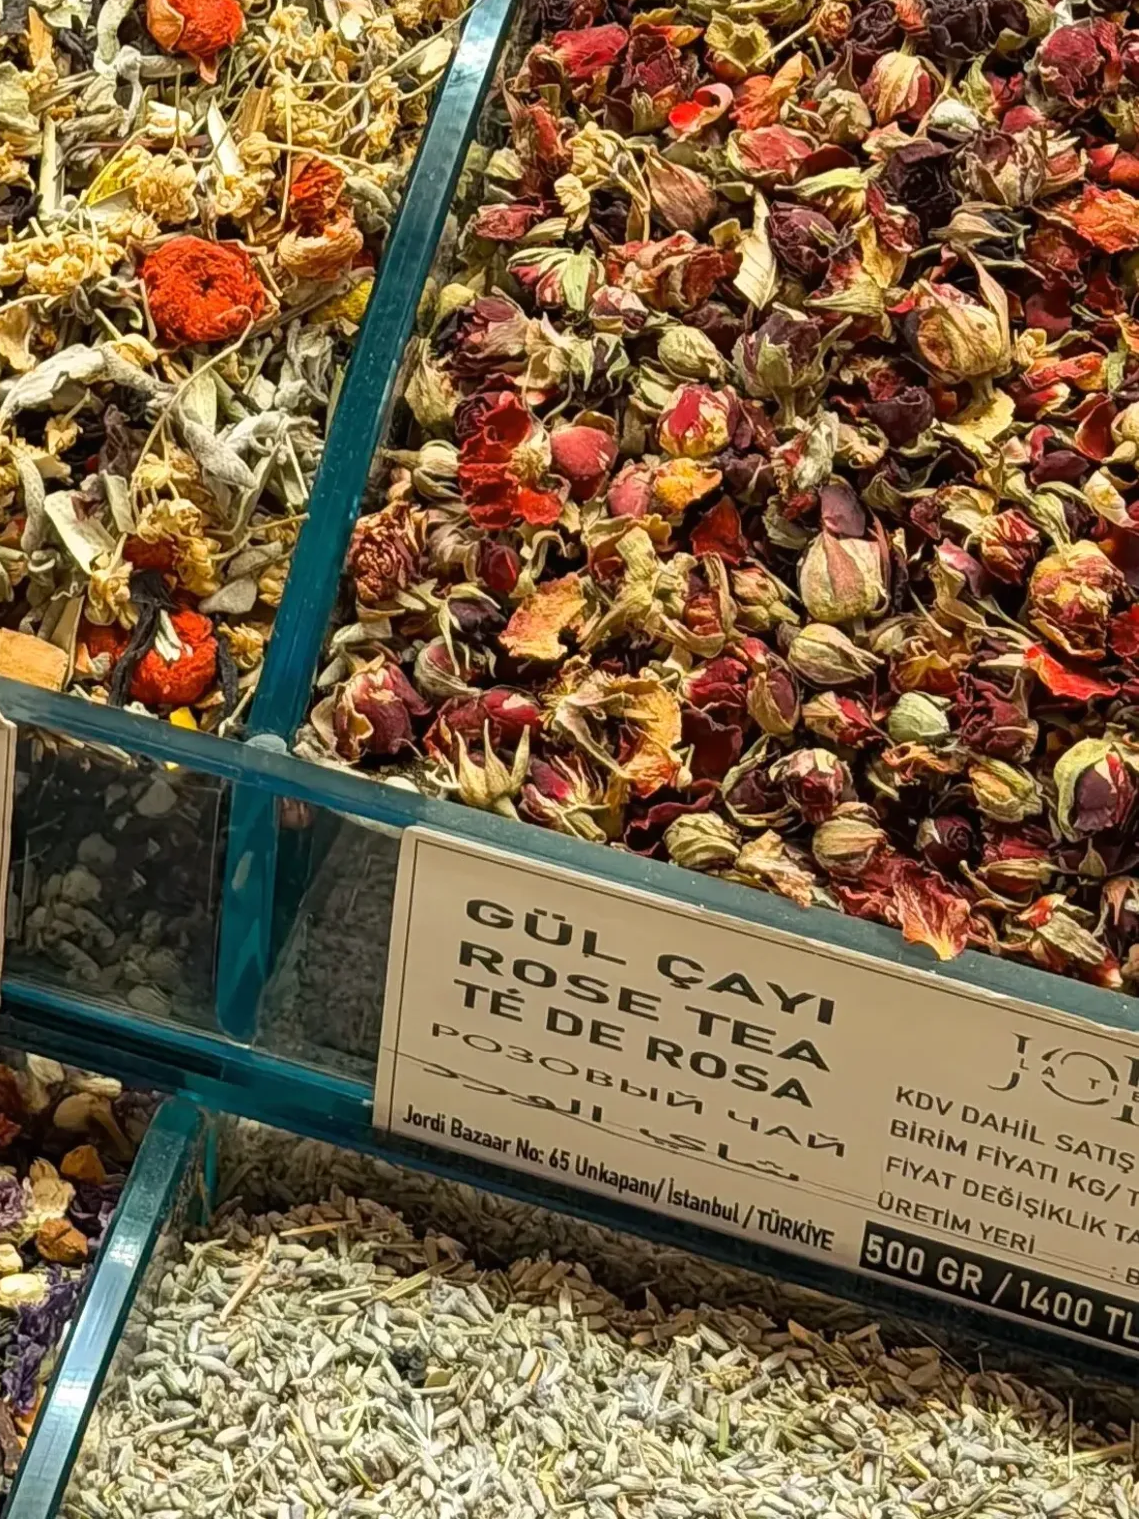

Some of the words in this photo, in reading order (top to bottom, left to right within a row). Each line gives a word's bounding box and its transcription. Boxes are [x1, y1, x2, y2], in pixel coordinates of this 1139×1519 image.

[459, 941, 660, 1022] ROSE
[685, 1005, 830, 1073] TEA
[466, 898, 627, 965] GÜL
[657, 953, 835, 1025] ÇAYI
[432, 1022, 703, 1115] РОЗОВЫЙ
[727, 1109, 845, 1158] ЧАЙ
[454, 979, 524, 1023] TÉ
[546, 1006, 625, 1052] DE
[646, 1035, 813, 1108] ROSA
[403, 1104, 445, 1133] Jordi
[451, 1119, 511, 1156] Bazaar
[549, 1146, 570, 1173] 65
[667, 1176, 738, 1225] İstanbul
[758, 1208, 835, 1253] TÜRKİYE
[890, 1119, 967, 1157] BİRİM
[977, 1145, 1058, 1183] FİYATI
[896, 1086, 953, 1116] KDV
[961, 1105, 1045, 1145] DAHİL
[1055, 1133, 1135, 1173] SATIŞ
[877, 1190, 971, 1235] ÜRETİM
[979, 1222, 1036, 1255] YERİ
[886, 1155, 957, 1191] FİYAT
[963, 1179, 1107, 1236] DEĞİŞİKLİK
[865, 1234, 925, 1275] 500
[937, 1257, 983, 1295] GR
[1020, 1280, 1093, 1327] 1400
[1104, 1305, 1139, 1343] TL
